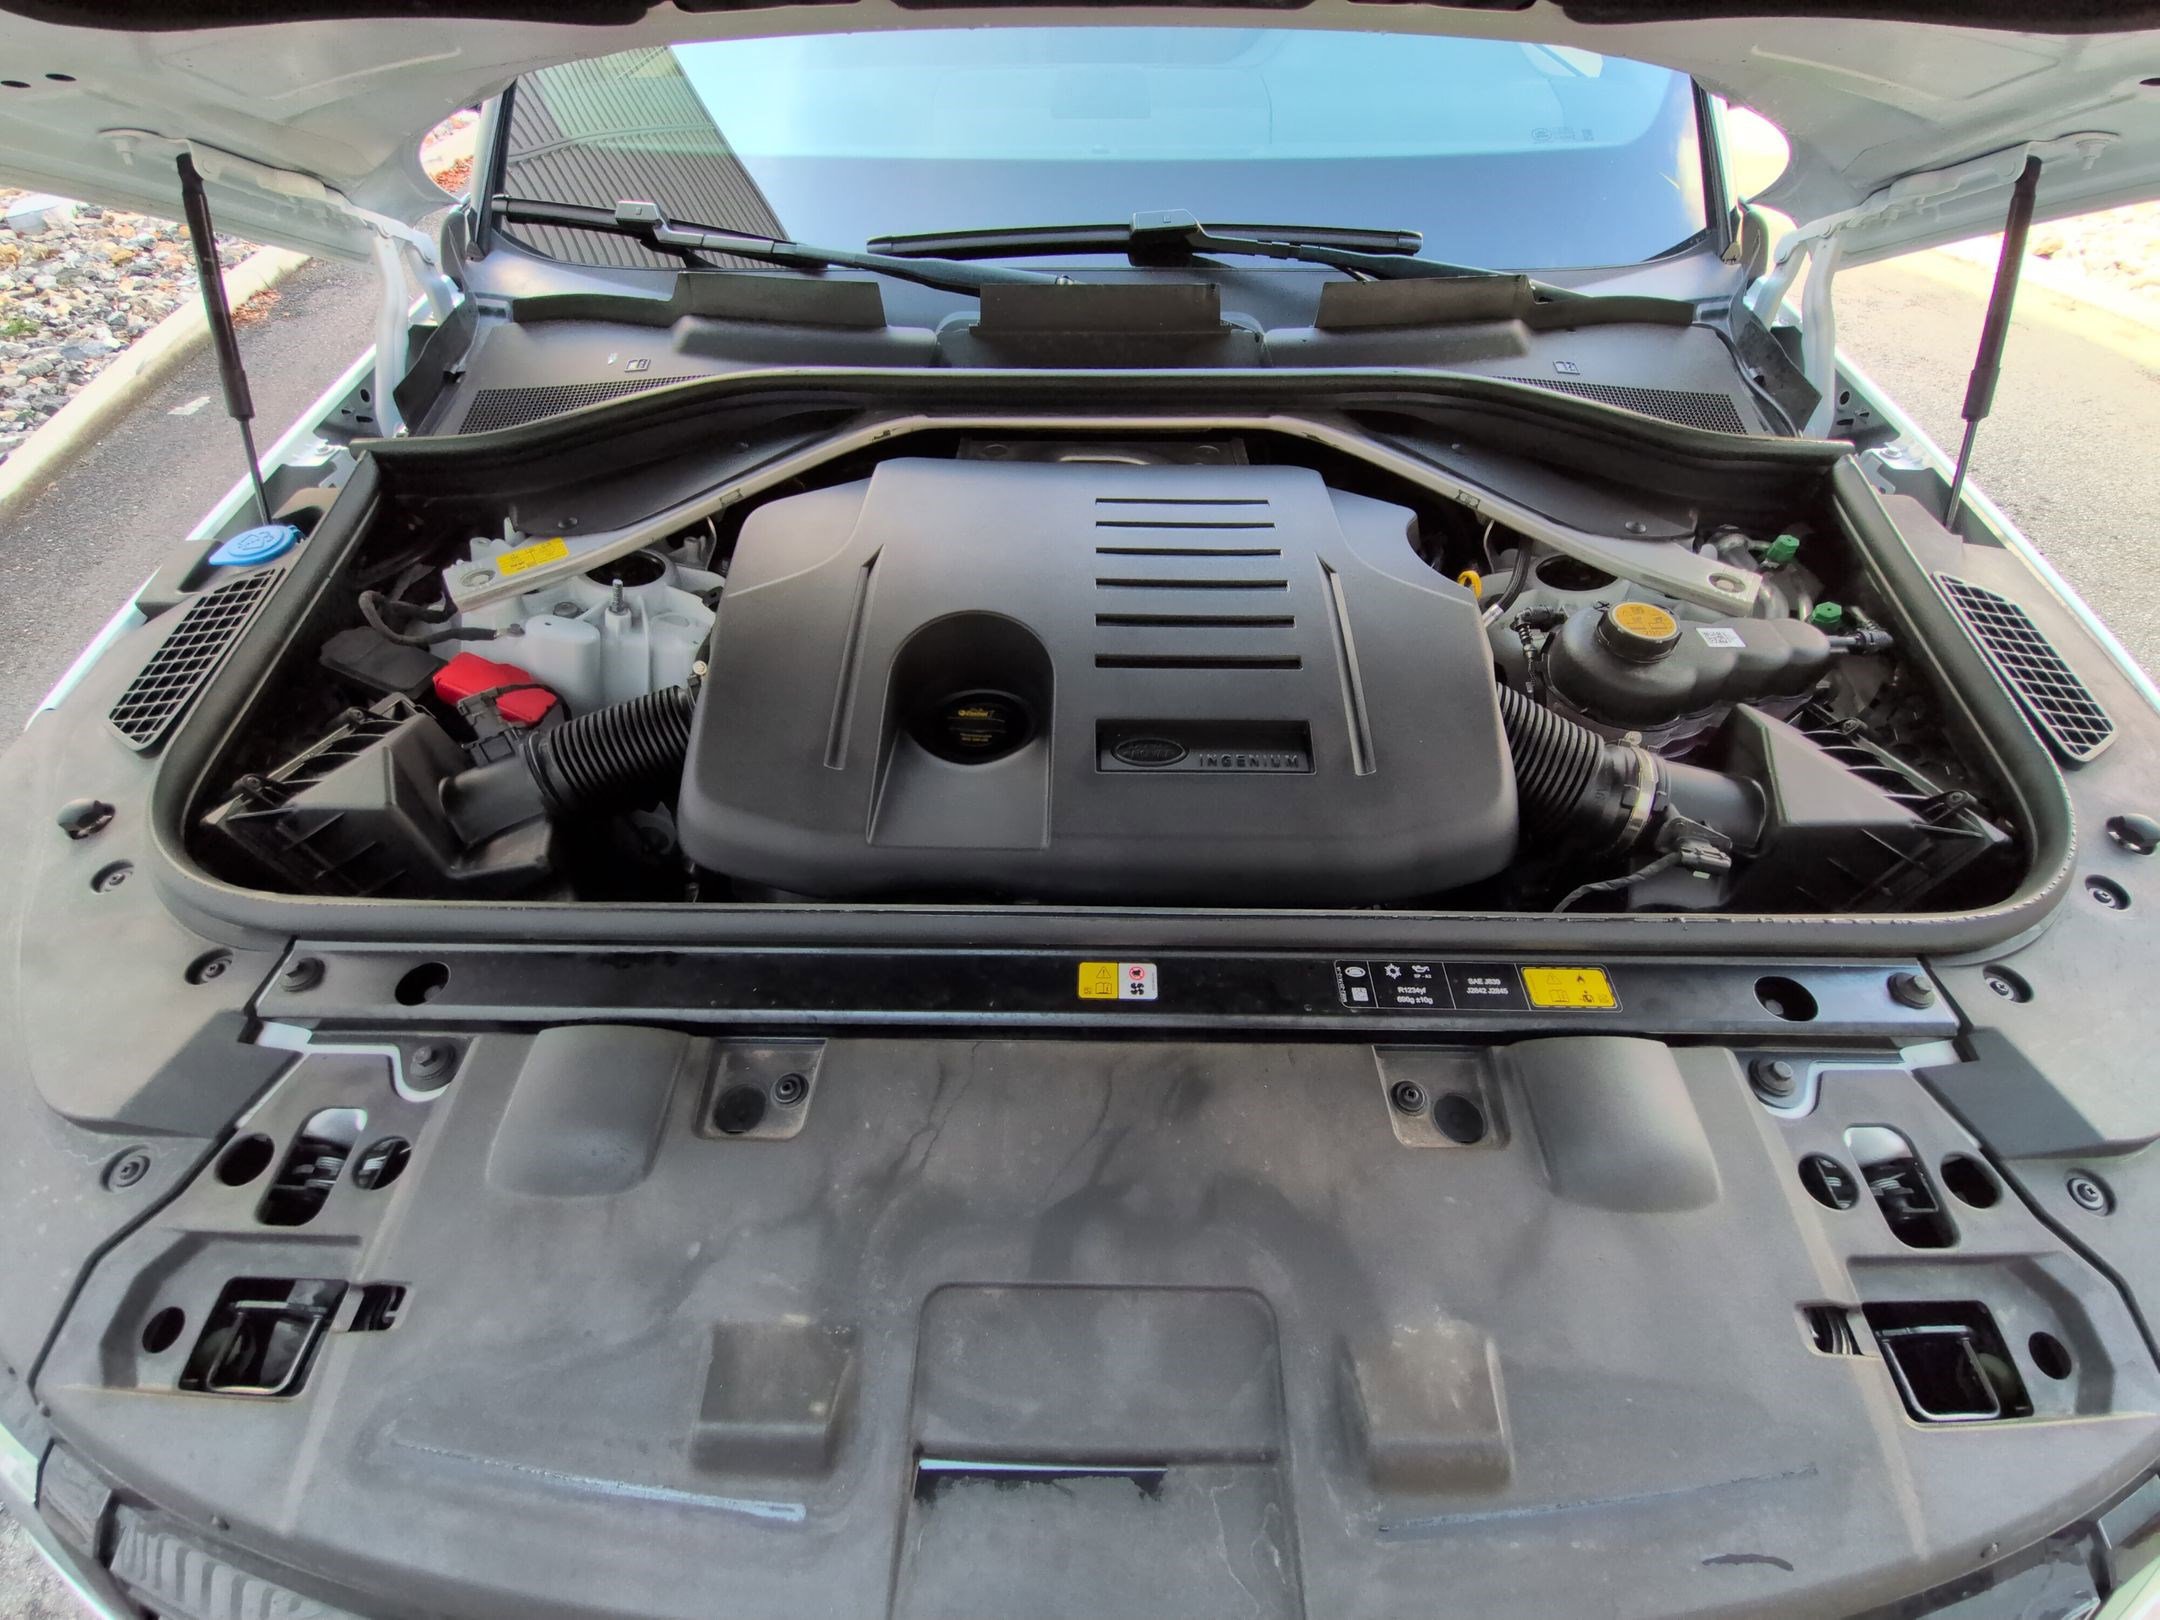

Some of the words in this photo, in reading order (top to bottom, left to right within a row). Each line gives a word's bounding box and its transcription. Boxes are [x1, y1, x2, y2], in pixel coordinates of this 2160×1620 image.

[1199, 753, 1299, 768] INGENIUM
[1467, 977, 1483, 985] SAE
[1397, 986, 1427, 995] R1234yf
